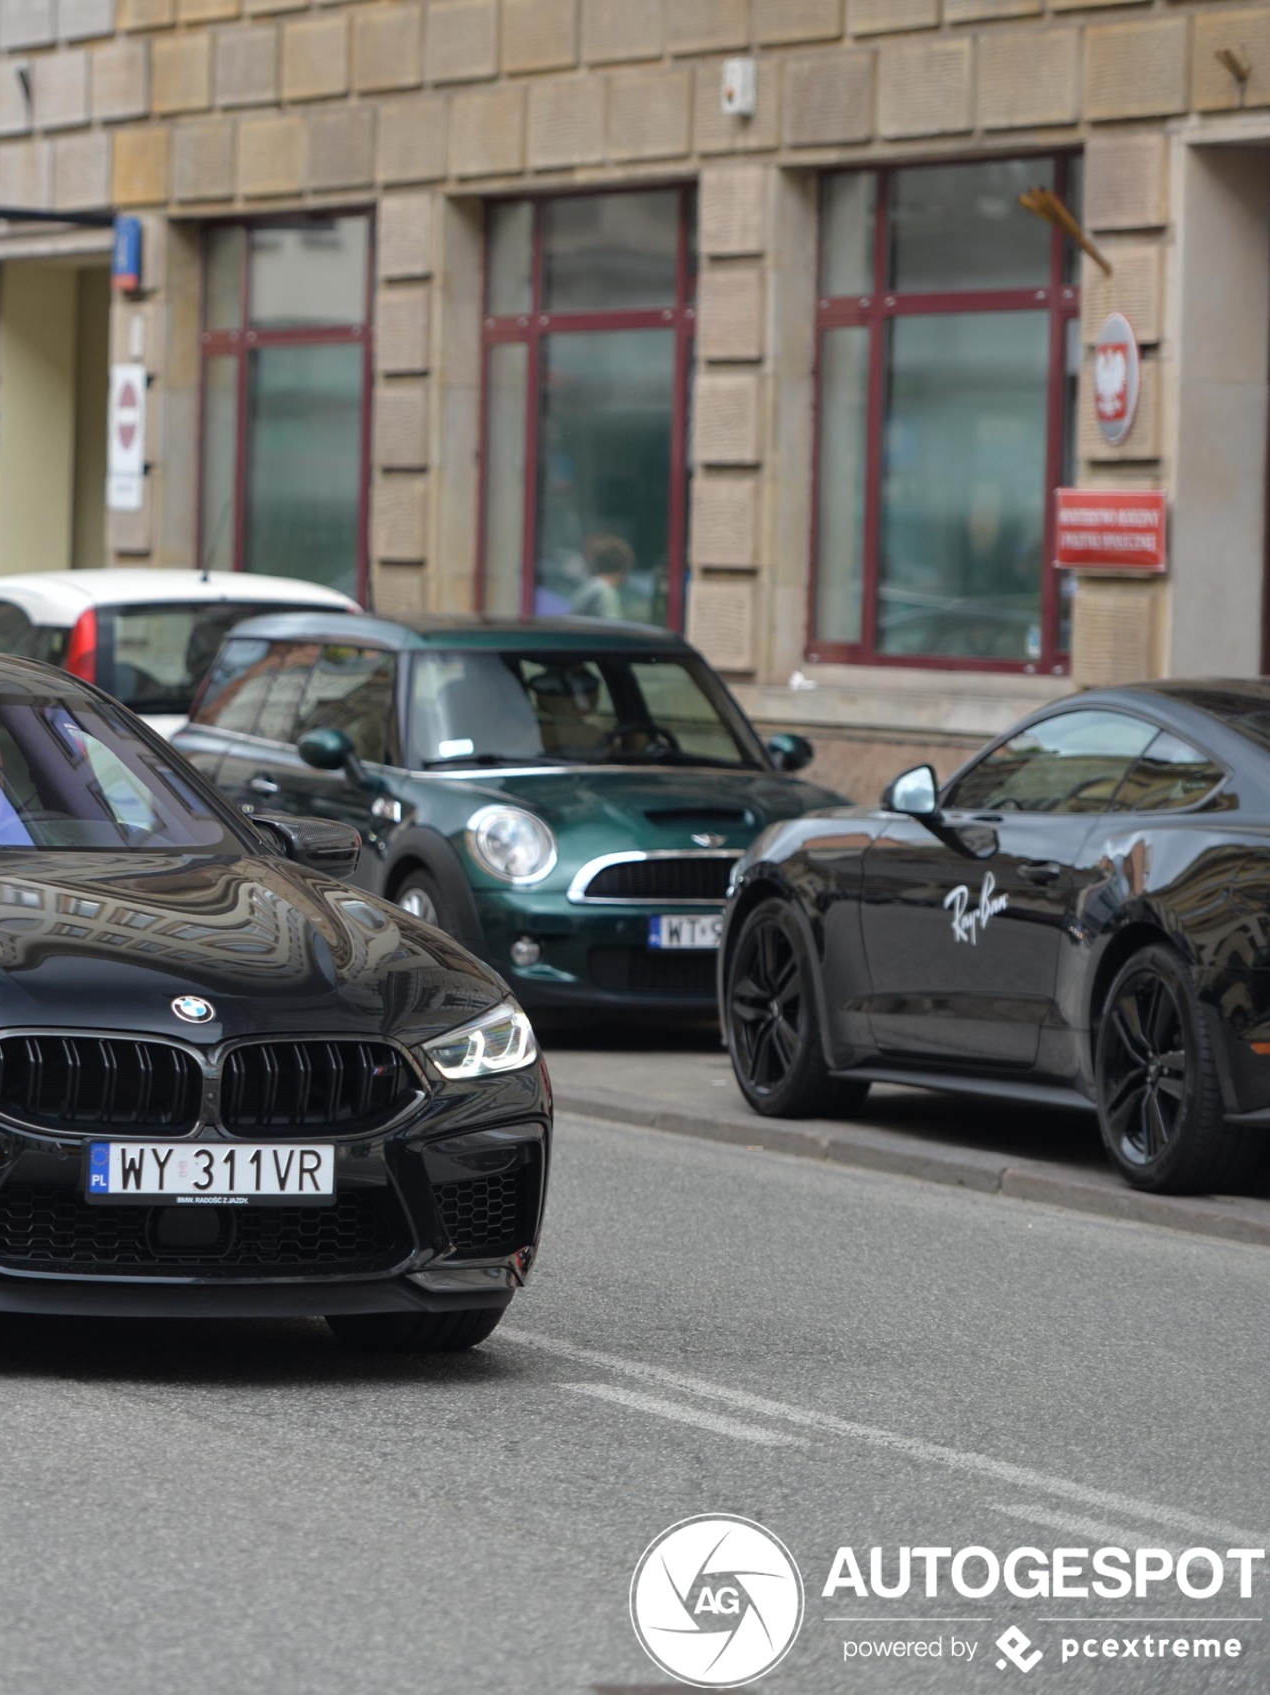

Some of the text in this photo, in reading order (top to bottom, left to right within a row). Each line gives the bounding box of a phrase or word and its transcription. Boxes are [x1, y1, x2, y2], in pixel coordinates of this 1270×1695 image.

[91, 1174, 107, 1187] PL
[121, 1148, 321, 1191] WY 311VR
